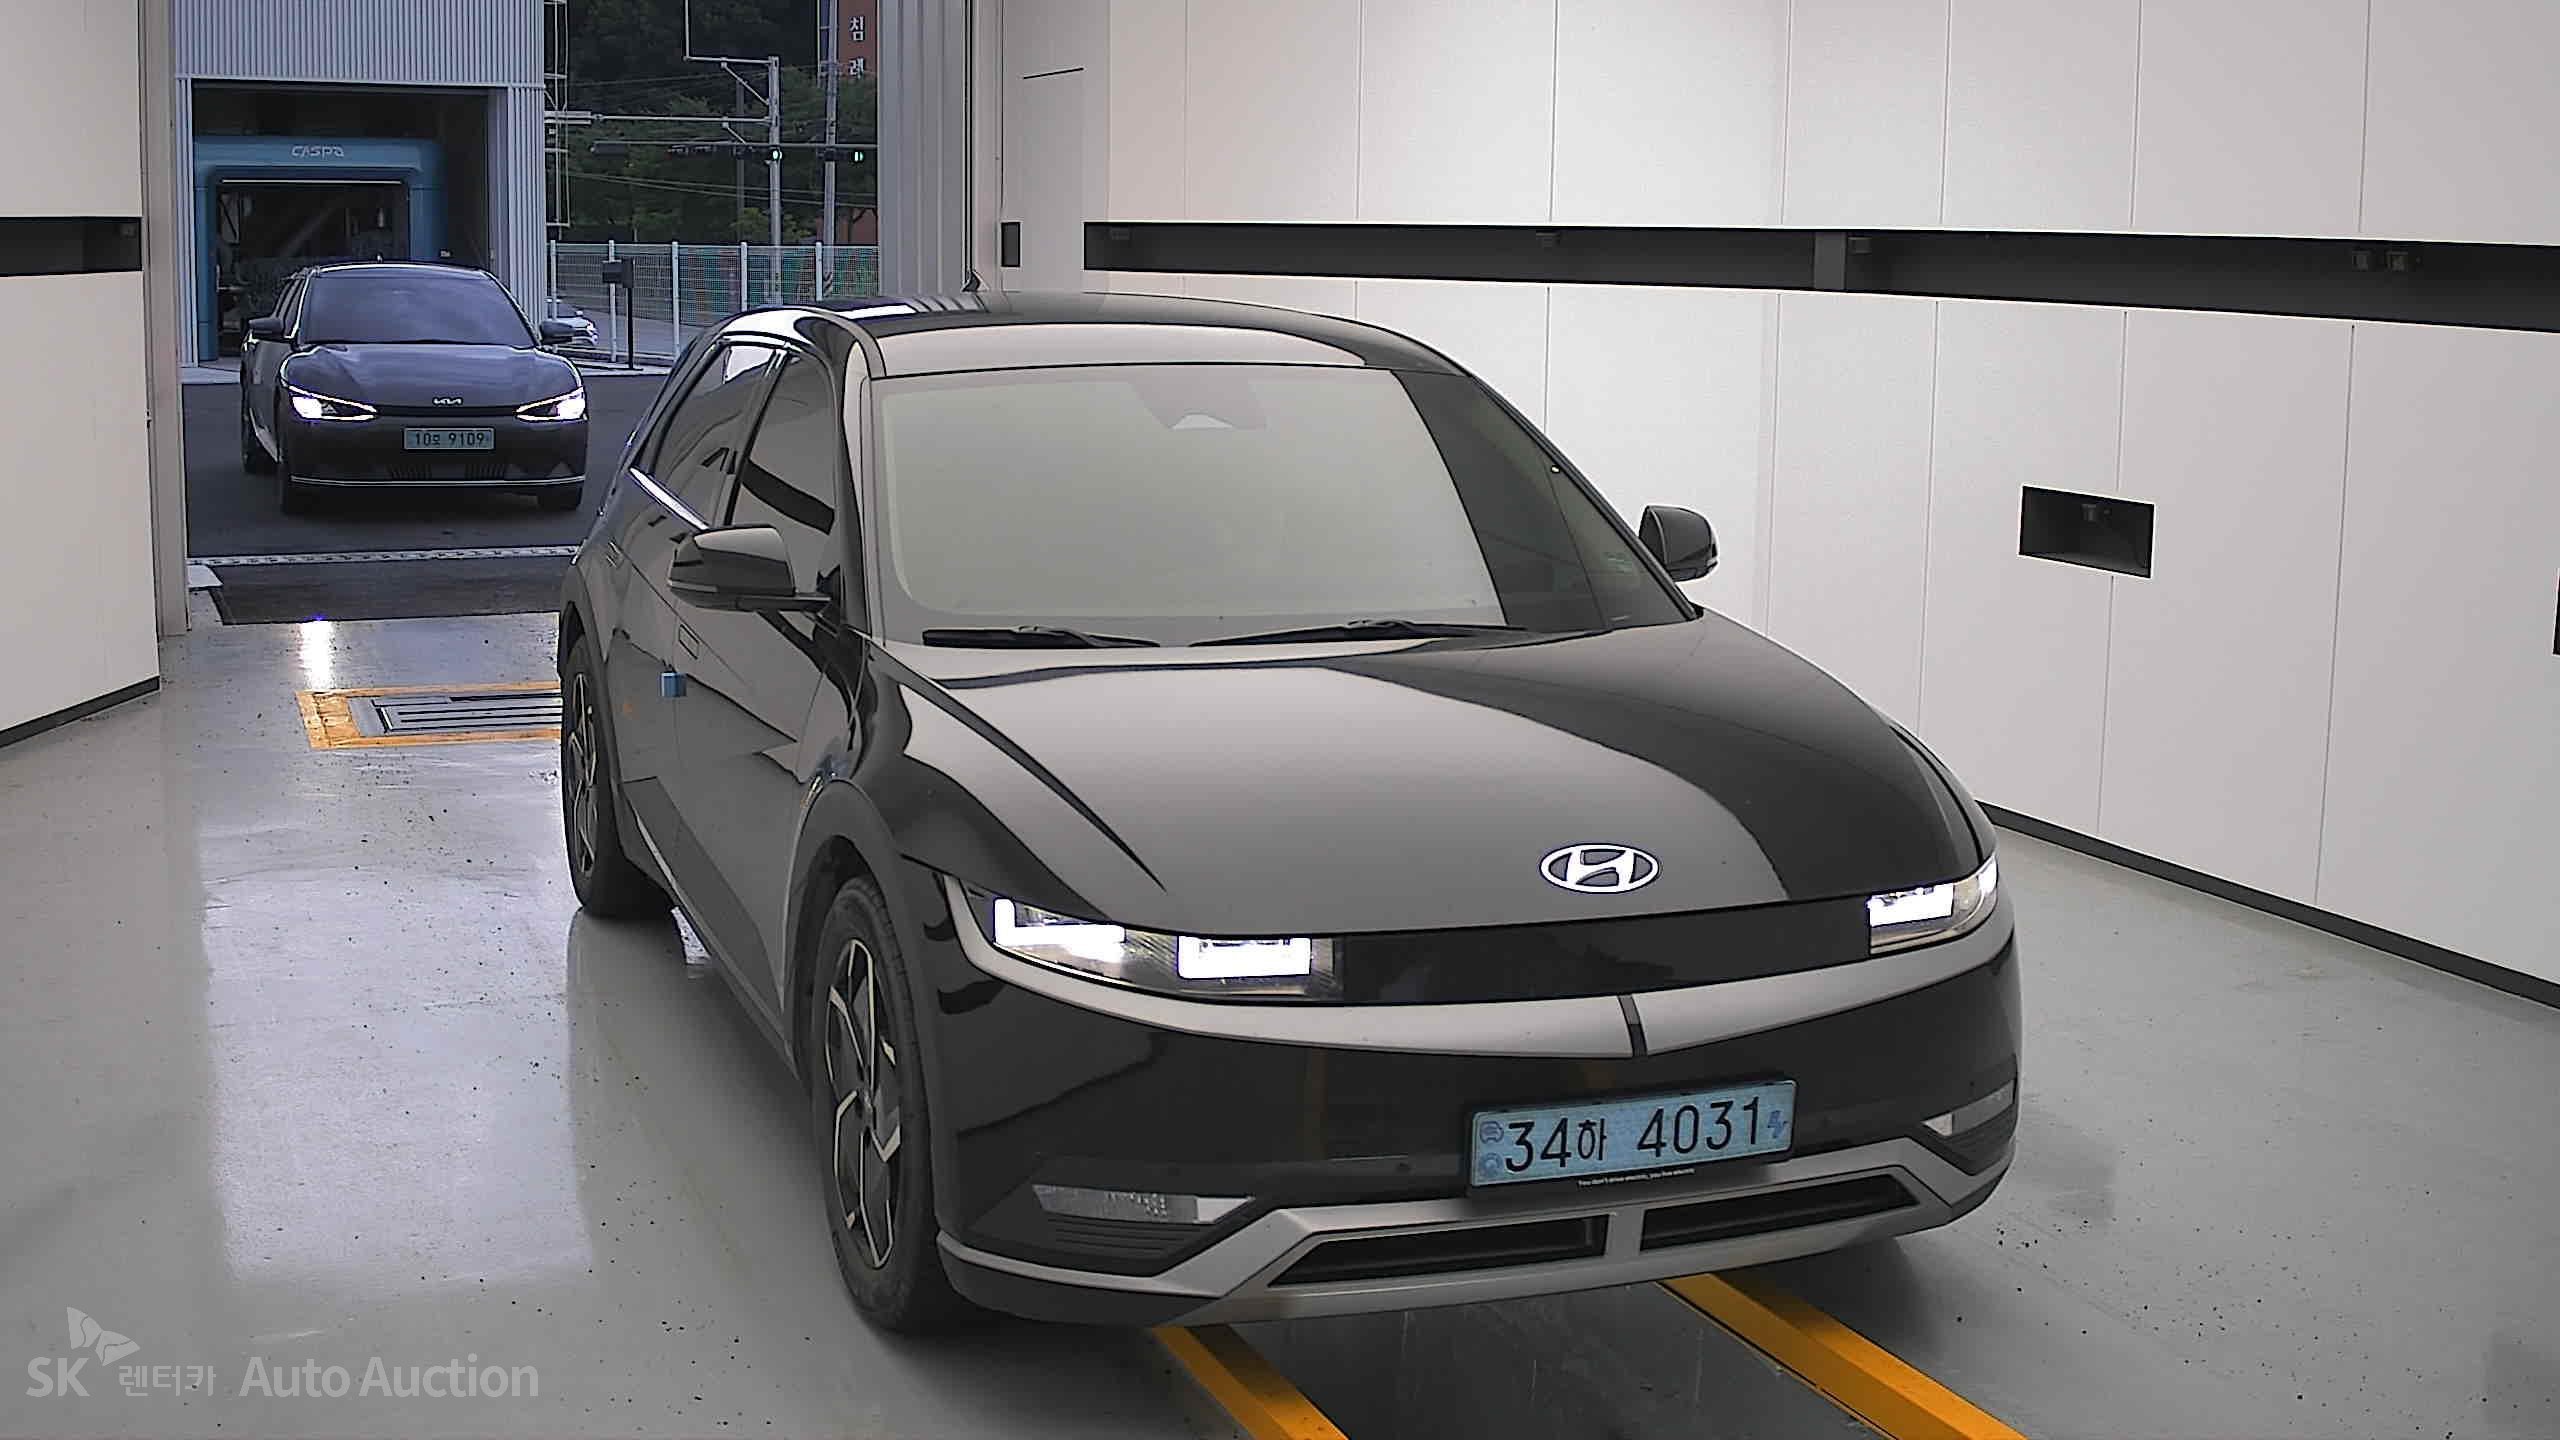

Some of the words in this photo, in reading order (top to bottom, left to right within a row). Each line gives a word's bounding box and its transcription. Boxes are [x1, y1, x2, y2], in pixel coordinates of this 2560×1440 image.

[448, 432, 485, 447] 9109
[1504, 1117, 1608, 1173] 34하
[1637, 1096, 1760, 1158] 4031
